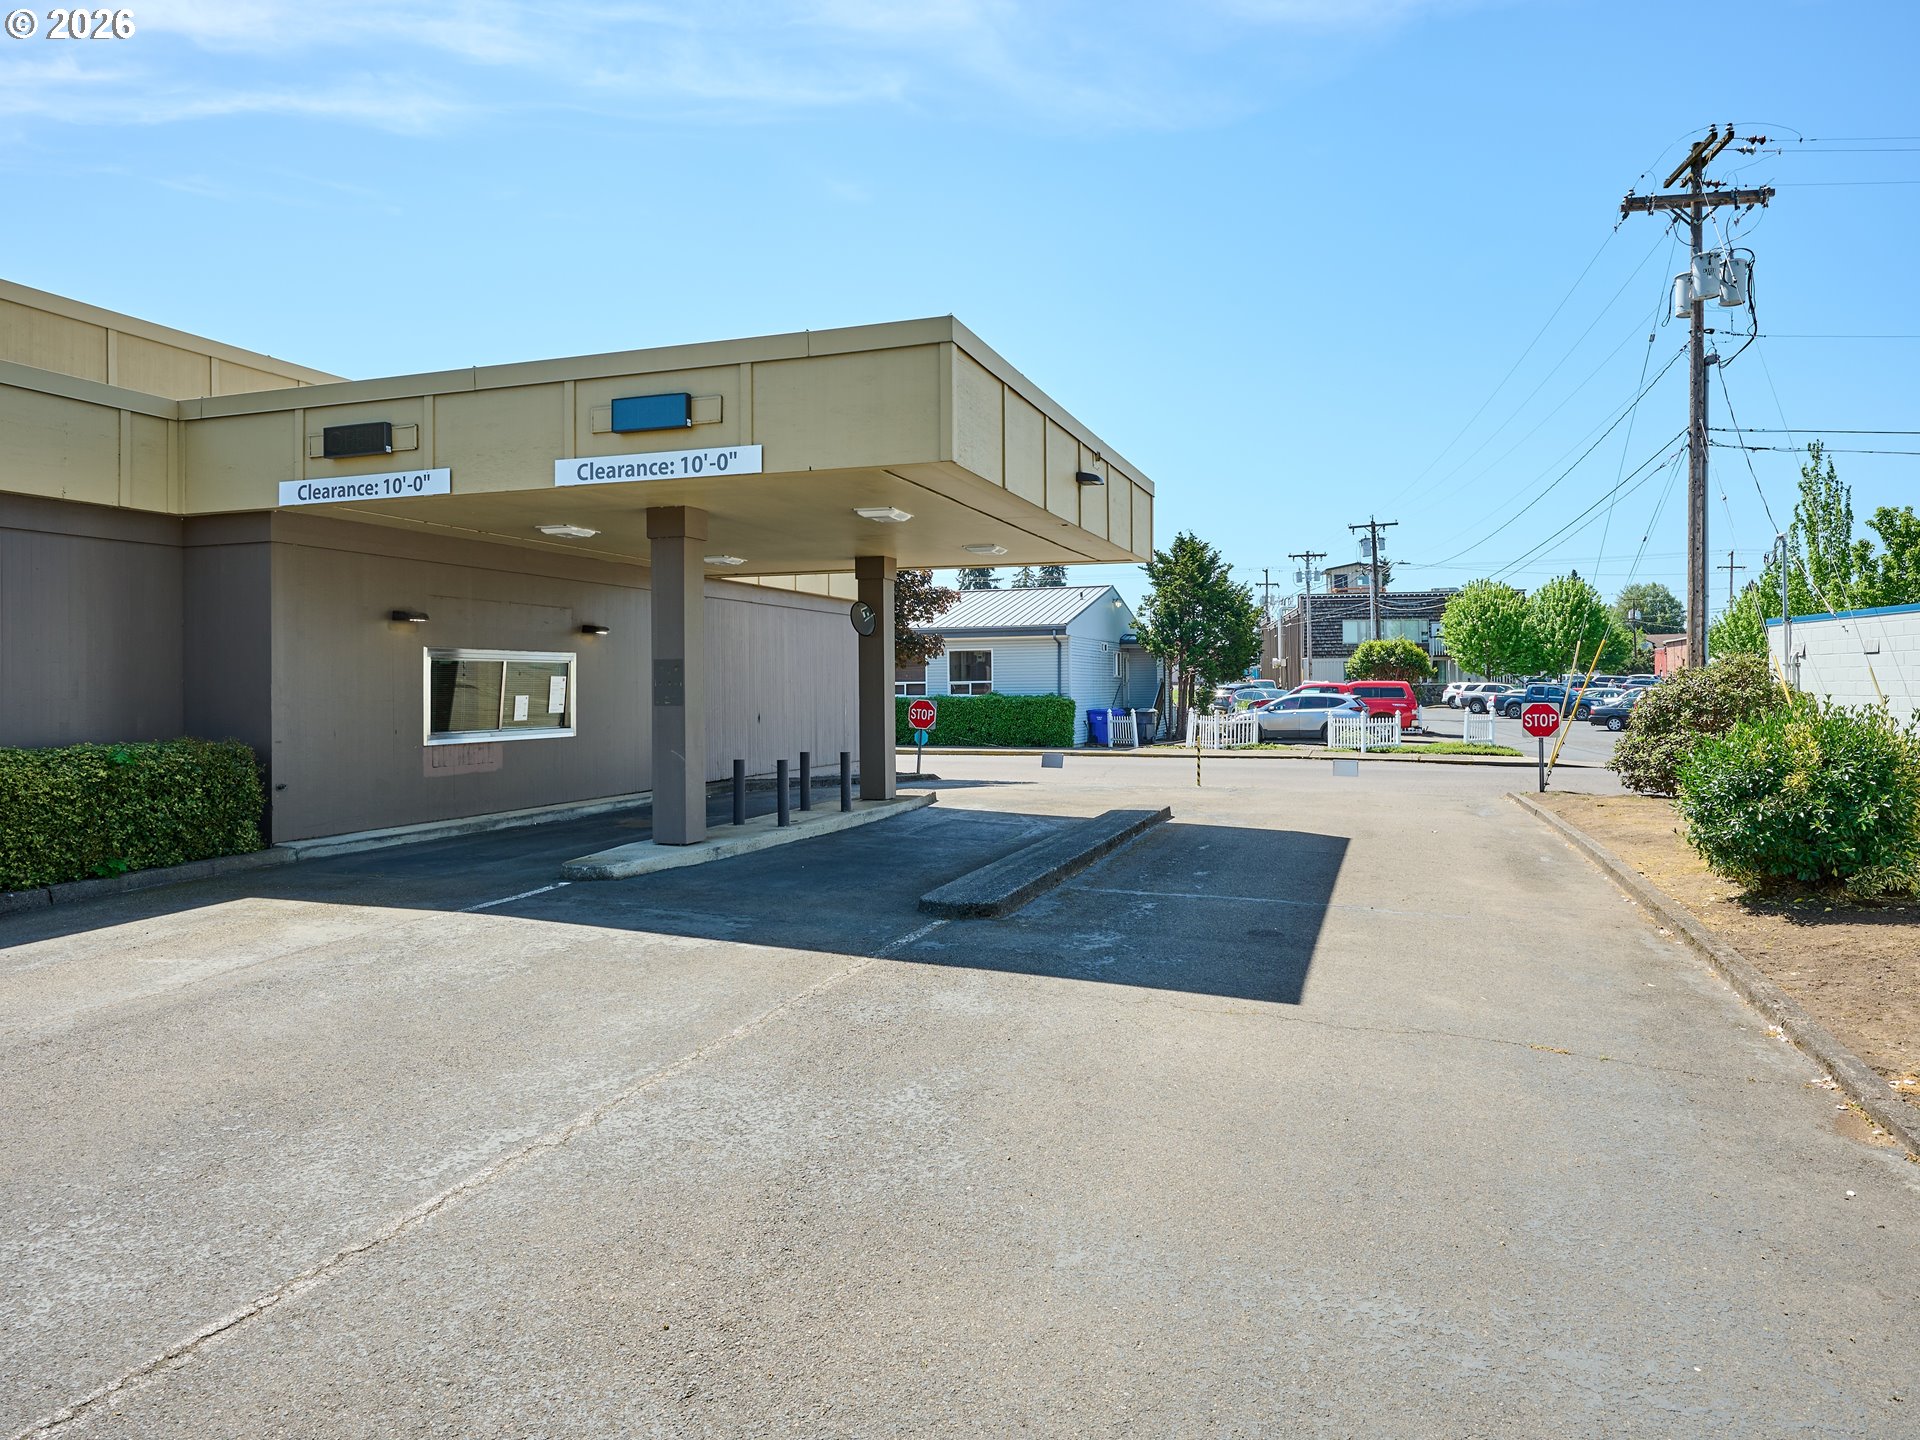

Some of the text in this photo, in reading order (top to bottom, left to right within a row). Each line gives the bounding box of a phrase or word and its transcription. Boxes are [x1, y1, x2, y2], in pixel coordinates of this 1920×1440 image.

[577, 451, 738, 480] Clearance: 10'-0"
[297, 474, 431, 500] Clearance: 10'-0"
[910, 708, 934, 720] STOP
[1524, 713, 1557, 727] STOP
